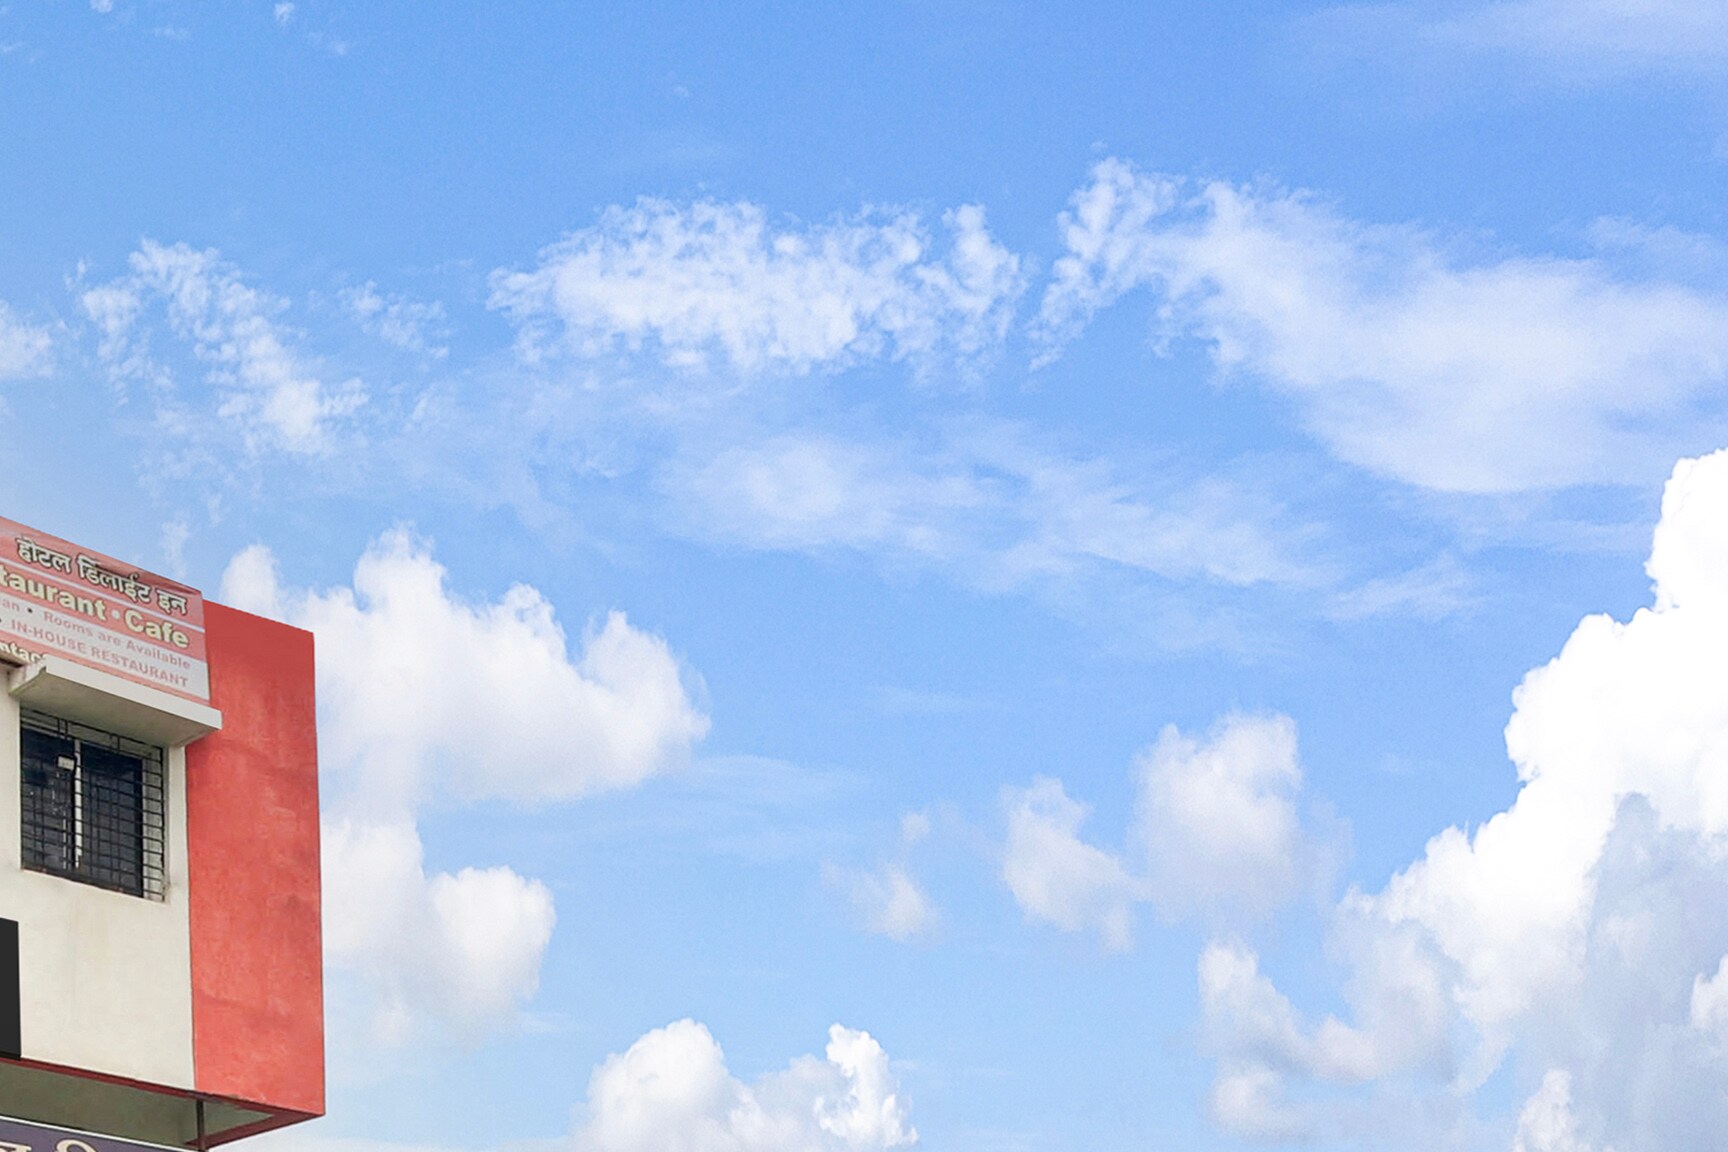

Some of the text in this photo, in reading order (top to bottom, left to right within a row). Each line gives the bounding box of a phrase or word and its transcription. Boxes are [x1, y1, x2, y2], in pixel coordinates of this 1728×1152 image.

[15, 536, 72, 574] होटल
[155, 588, 188, 615] इन
[11, 619, 86, 655] IN-HOUSE
[91, 646, 189, 687] RESTAURANT
[43, 611, 94, 637] Rooms
[98, 629, 121, 646] are
[127, 640, 192, 670] Available
[125, 609, 189, 649] Cafe
